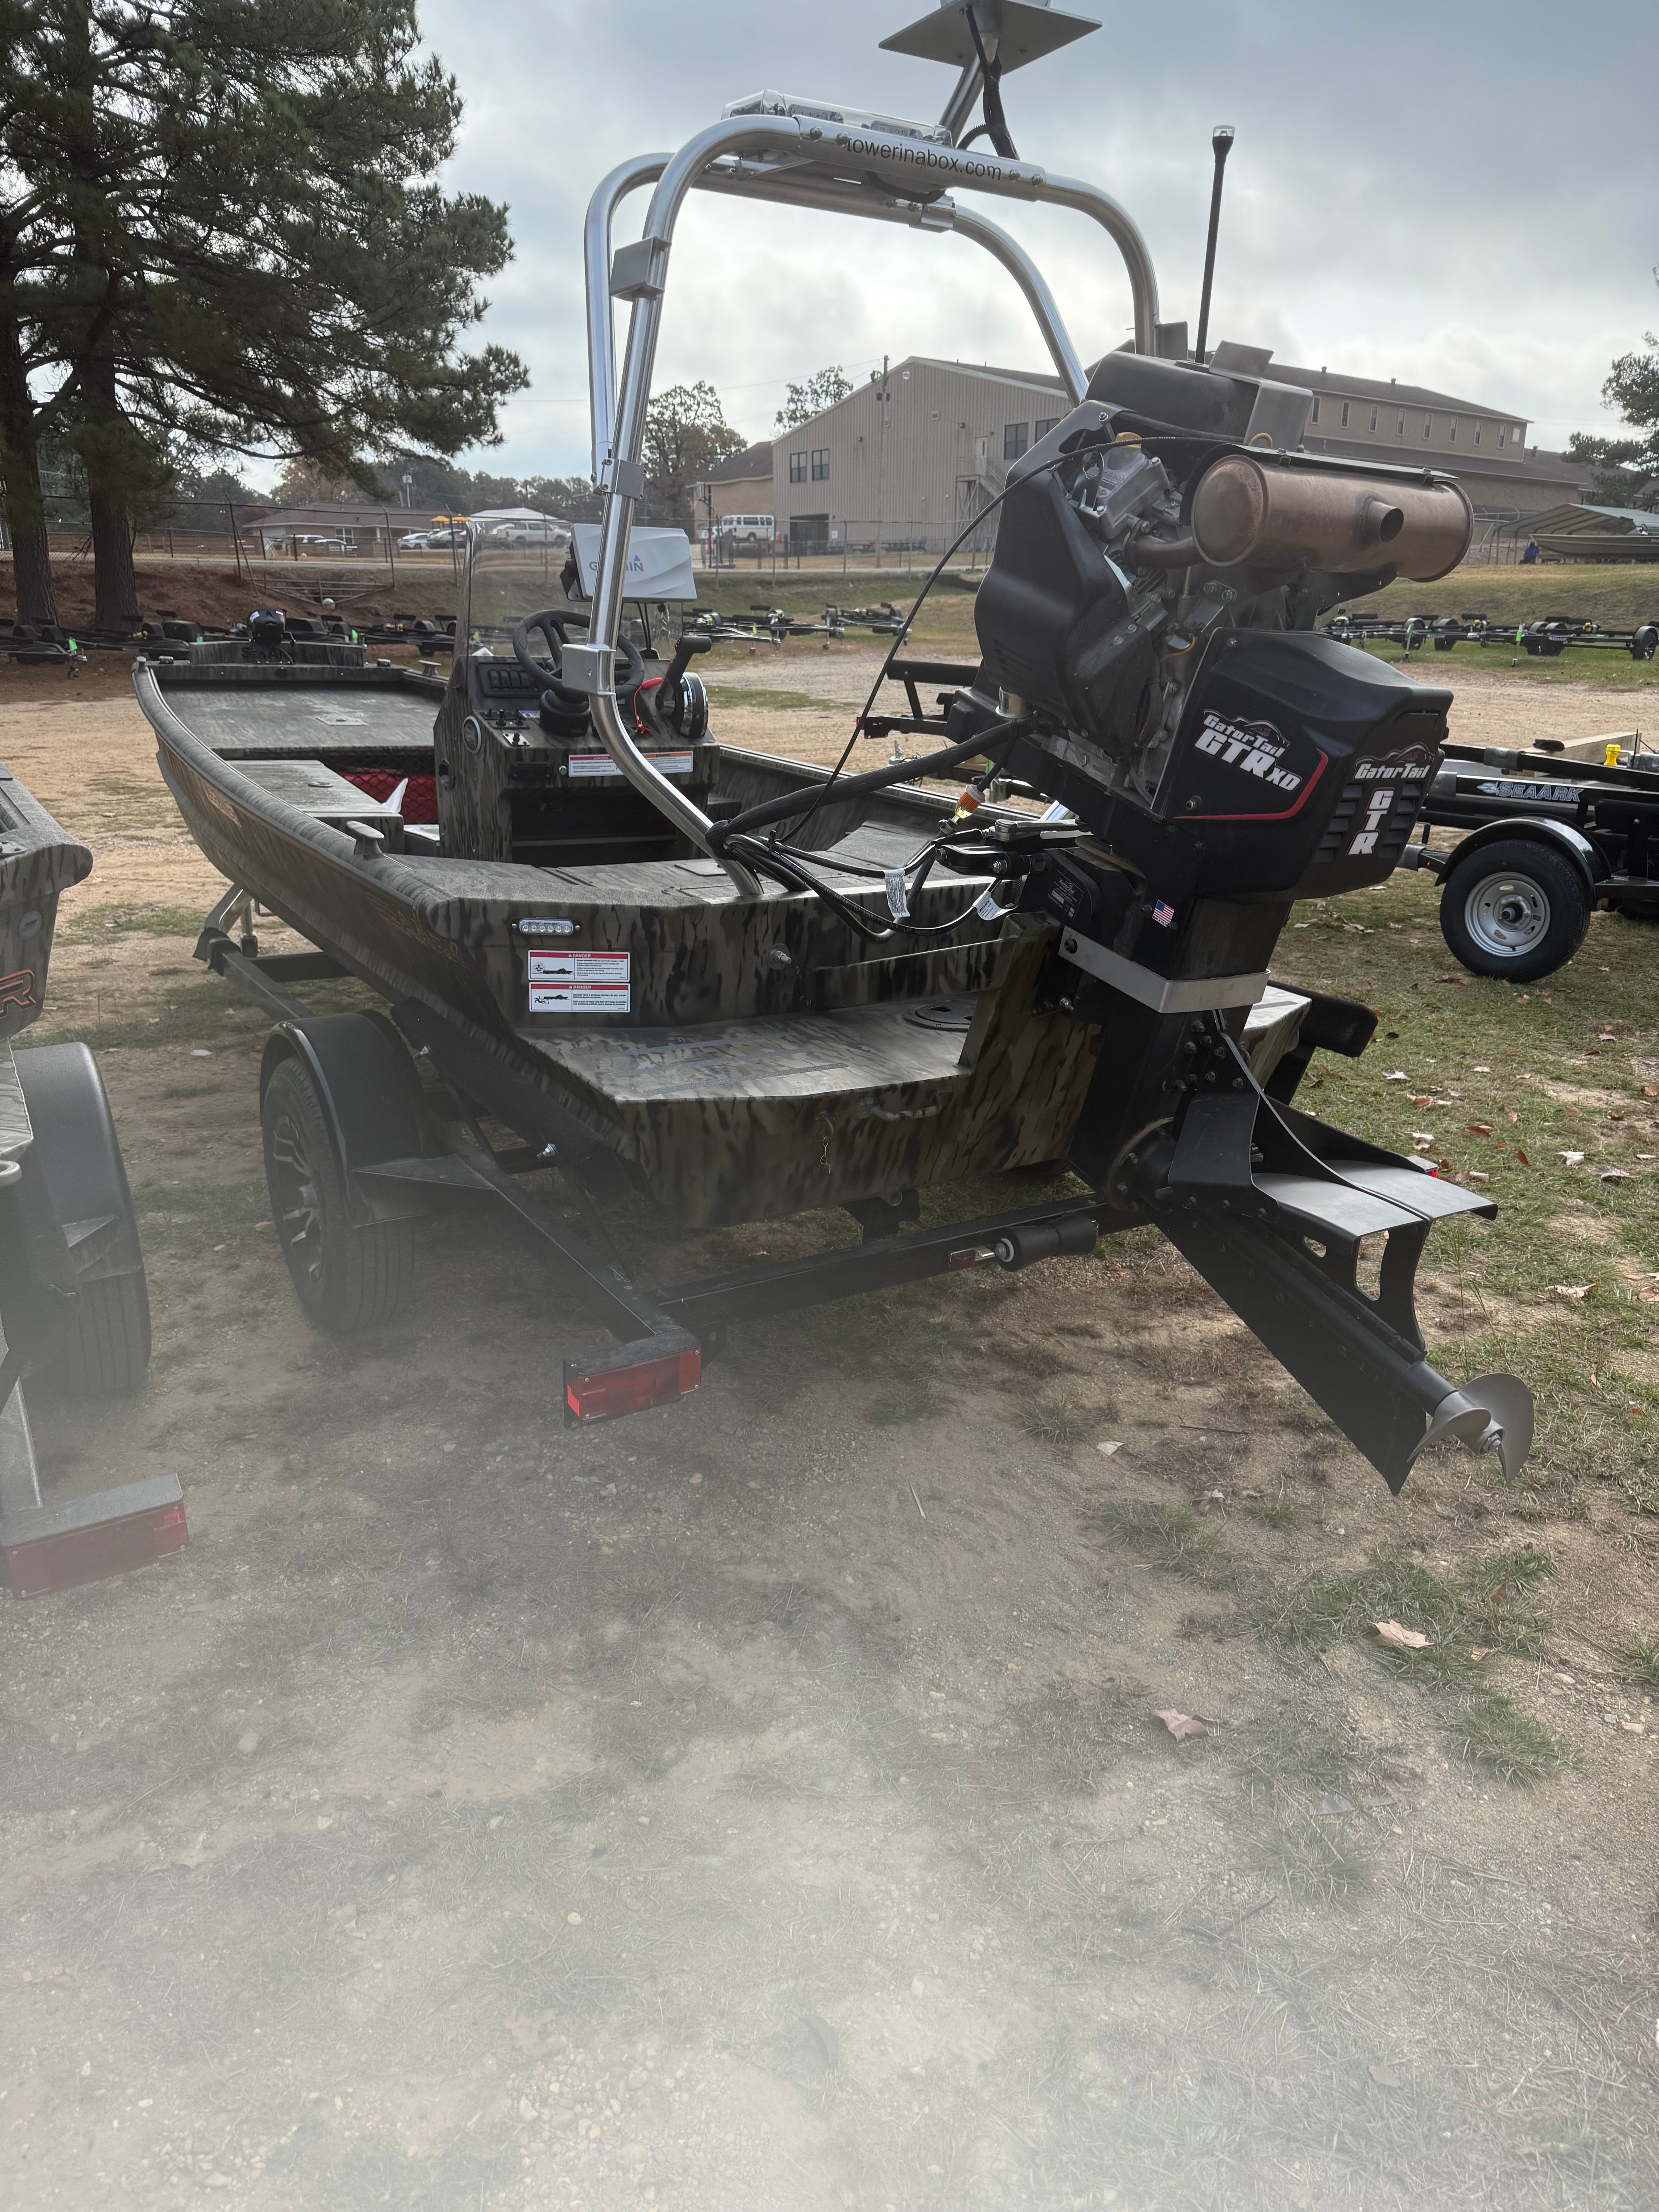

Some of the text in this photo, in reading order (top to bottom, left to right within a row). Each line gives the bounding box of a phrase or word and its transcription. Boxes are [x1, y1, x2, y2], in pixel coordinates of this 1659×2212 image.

[847, 137, 1002, 181] towerinabox.com
[589, 561, 643, 572] GIN
[1203, 714, 1286, 757] GatorTail
[1354, 763, 1431, 780] GatorTail
